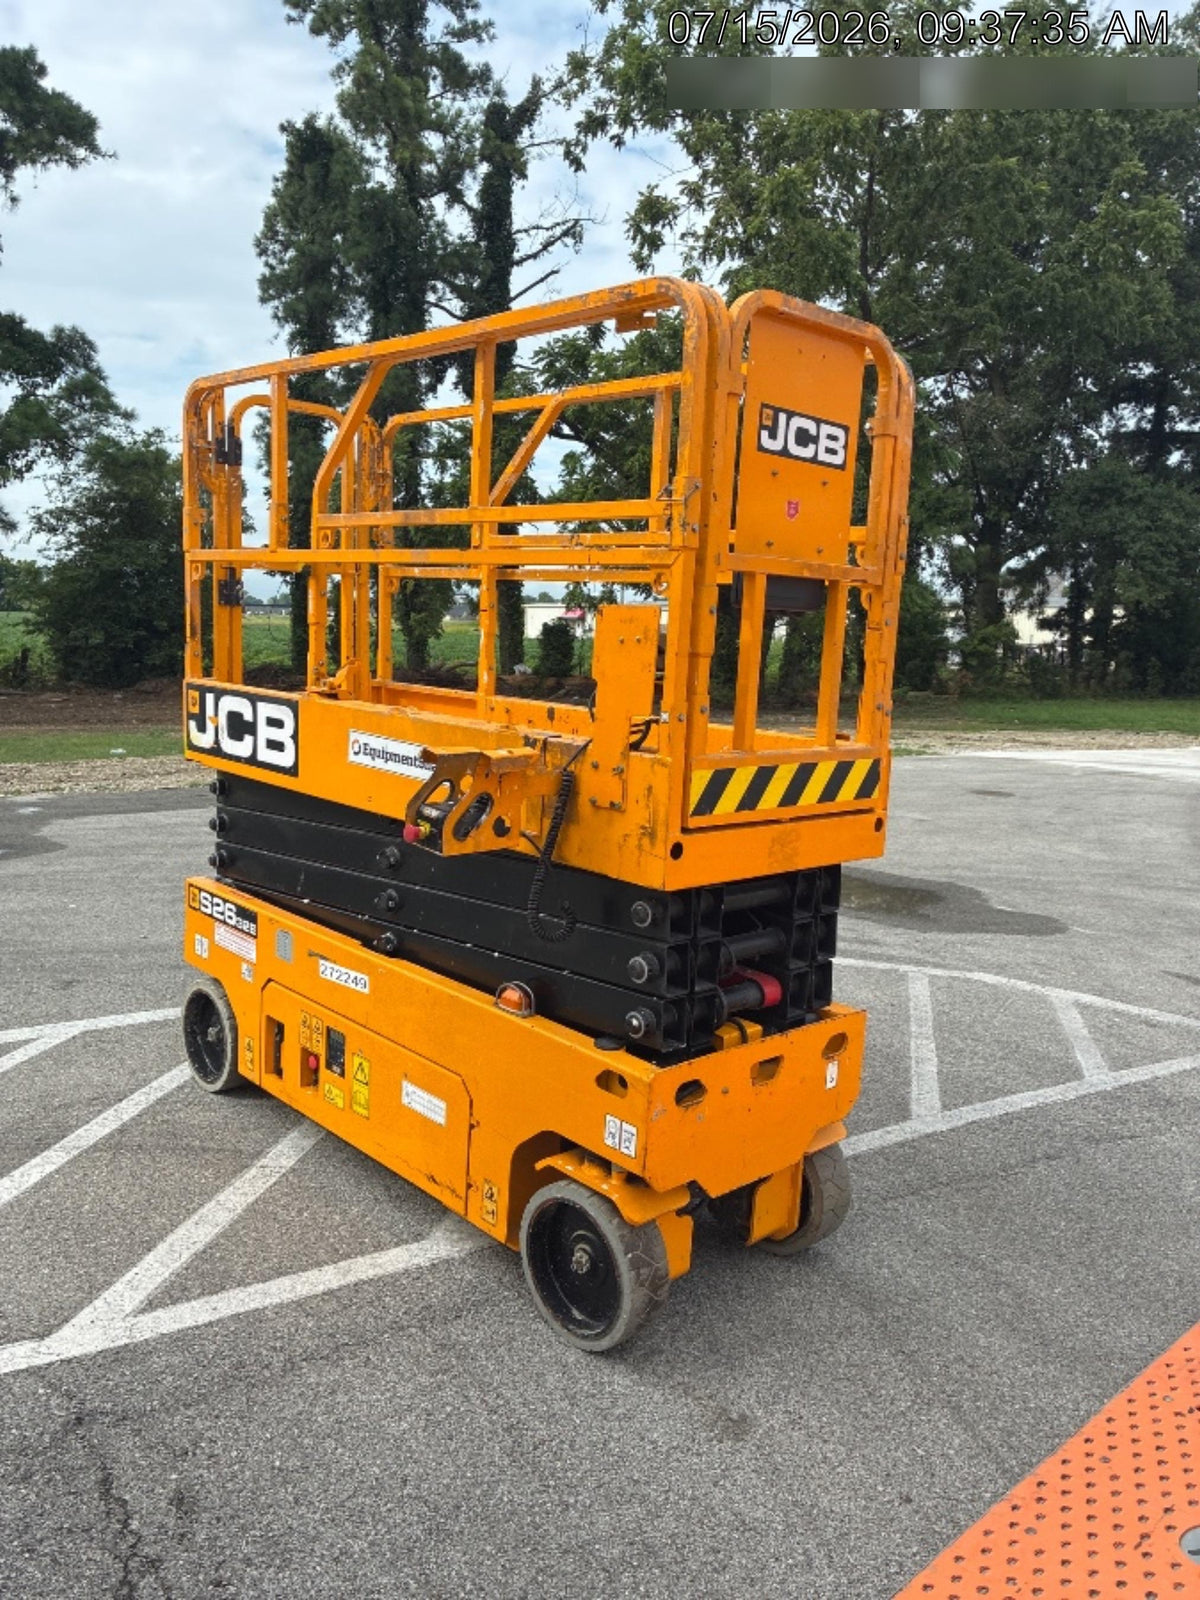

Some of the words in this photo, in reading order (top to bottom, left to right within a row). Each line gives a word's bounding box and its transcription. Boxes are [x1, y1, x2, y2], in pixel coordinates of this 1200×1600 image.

[760, 411, 846, 465] JCB
[188, 692, 296, 769] JCB
[320, 962, 367, 990] 272249
